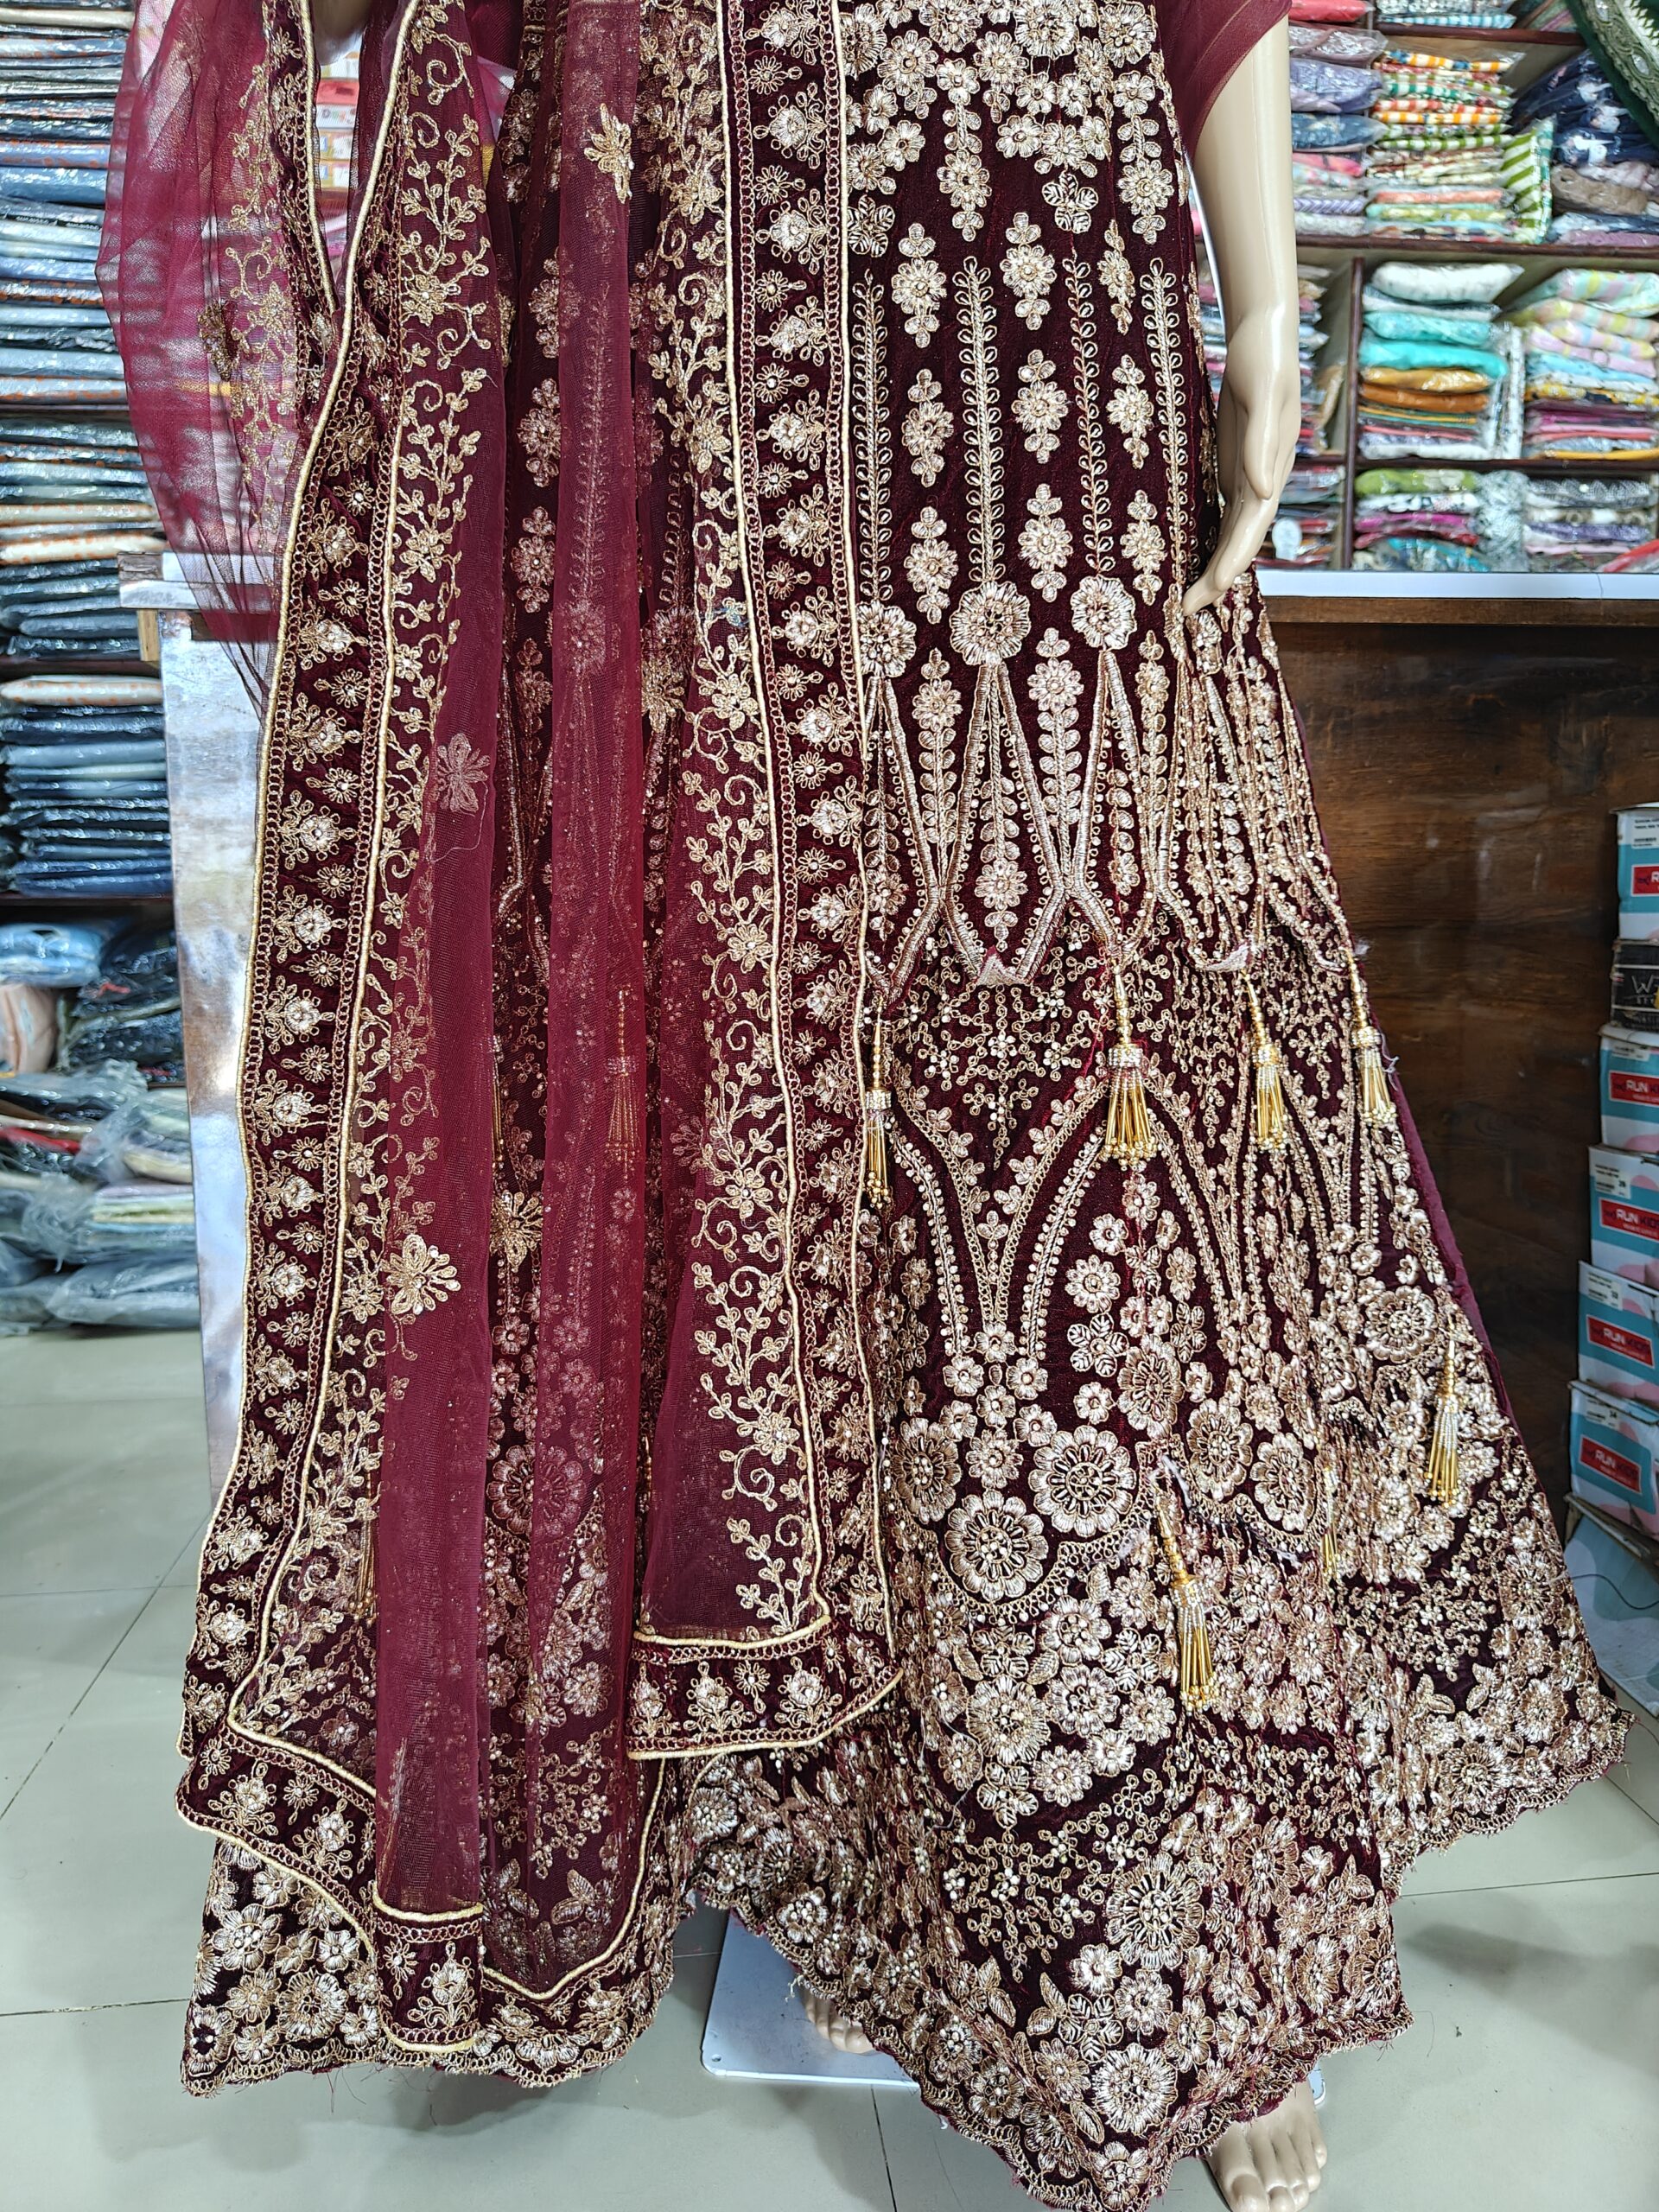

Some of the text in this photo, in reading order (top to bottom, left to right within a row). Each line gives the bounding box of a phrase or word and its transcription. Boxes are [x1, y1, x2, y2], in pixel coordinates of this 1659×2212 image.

[1626, 1079, 1649, 1093] RUN
[1616, 1209, 1639, 1224] RUN
[1604, 1327, 1626, 1344] RUN
[1594, 1450, 1617, 1469] RUN
